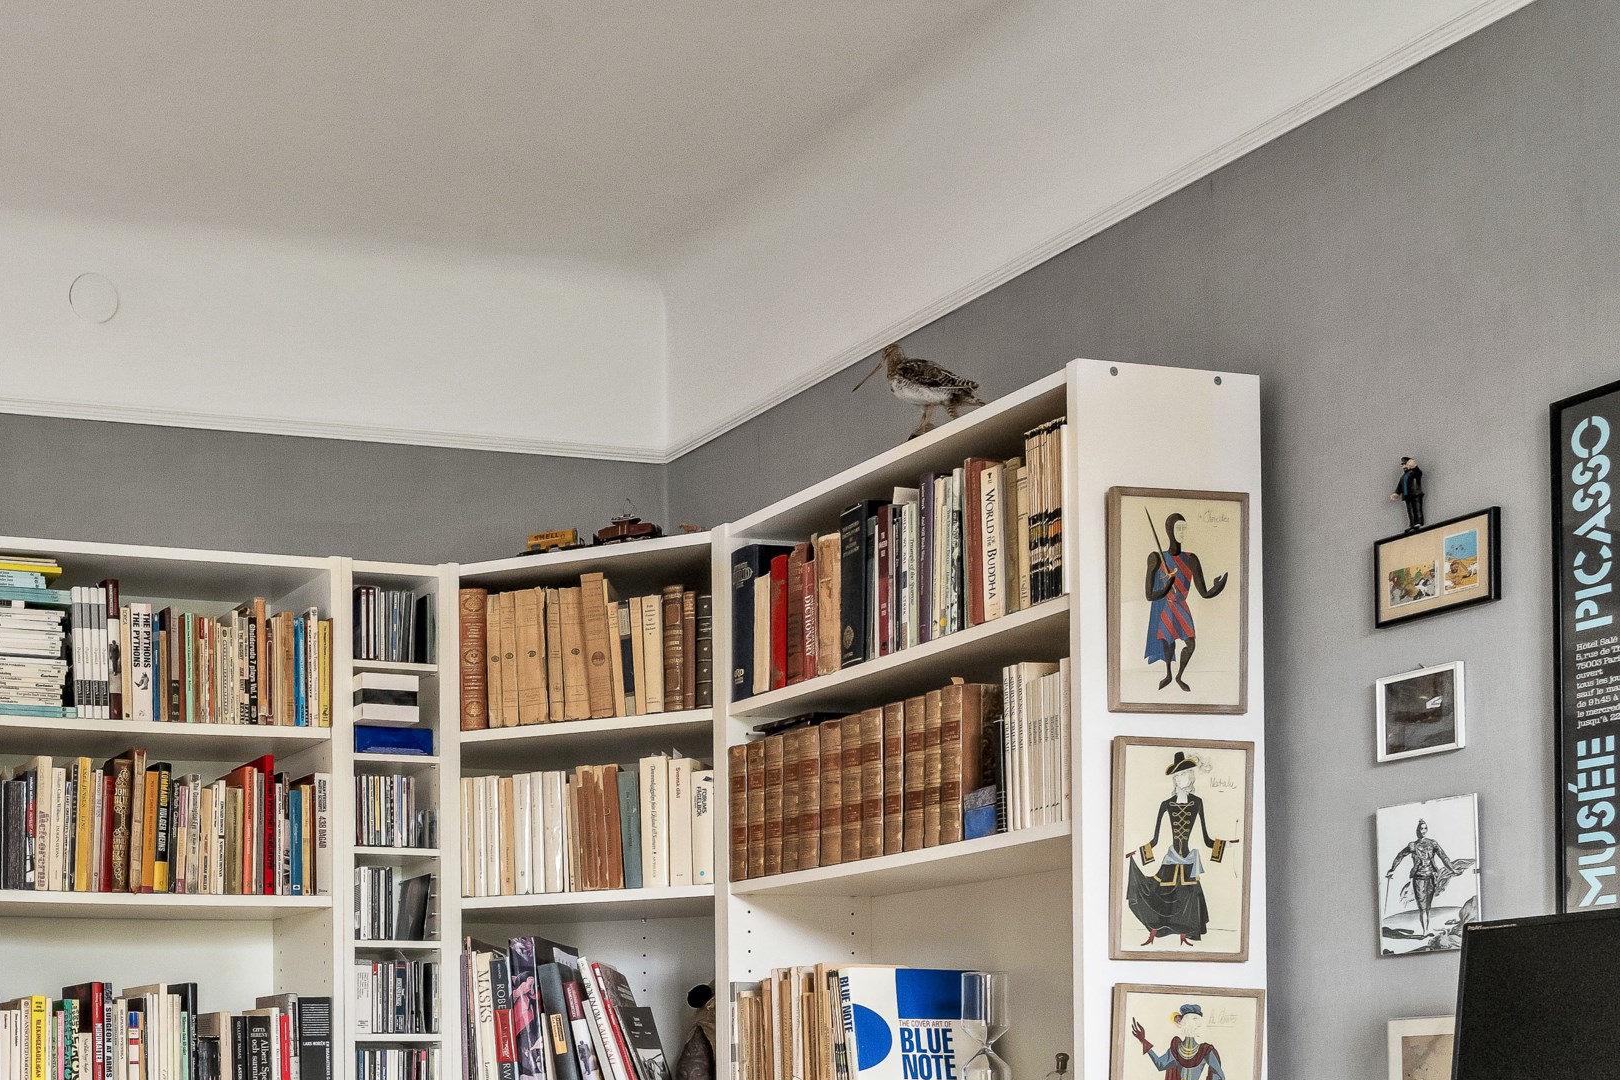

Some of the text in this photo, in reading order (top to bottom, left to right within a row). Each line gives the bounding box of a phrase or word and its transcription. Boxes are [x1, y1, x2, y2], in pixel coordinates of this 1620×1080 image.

[985, 488, 995, 533] WORLD
[1571, 416, 1613, 631] PICASSO
[987, 549, 997, 599] BUDDHA
[804, 595, 813, 657] DICTIONARY
[1576, 636, 1618, 651] Hôtel Salé
[143, 630, 151, 668] PYTHONS
[1576, 669, 1603, 679] ouvert
[1576, 680, 1594, 689] tous
[1596, 677, 1608, 685] les
[1576, 689, 1595, 698] sauf
[158, 771, 169, 852] KOMMANDO HOLGER MEINS
[318, 816, 326, 828] 438
[1567, 735, 1616, 907] MUSÉE
[477, 970, 492, 1024] MASKS
[840, 976, 853, 1033] BLUE NOTE
[261, 1040, 269, 1064] Albert
[900, 1028, 954, 1053] BLUE
[903, 1055, 957, 1080] NOTE
